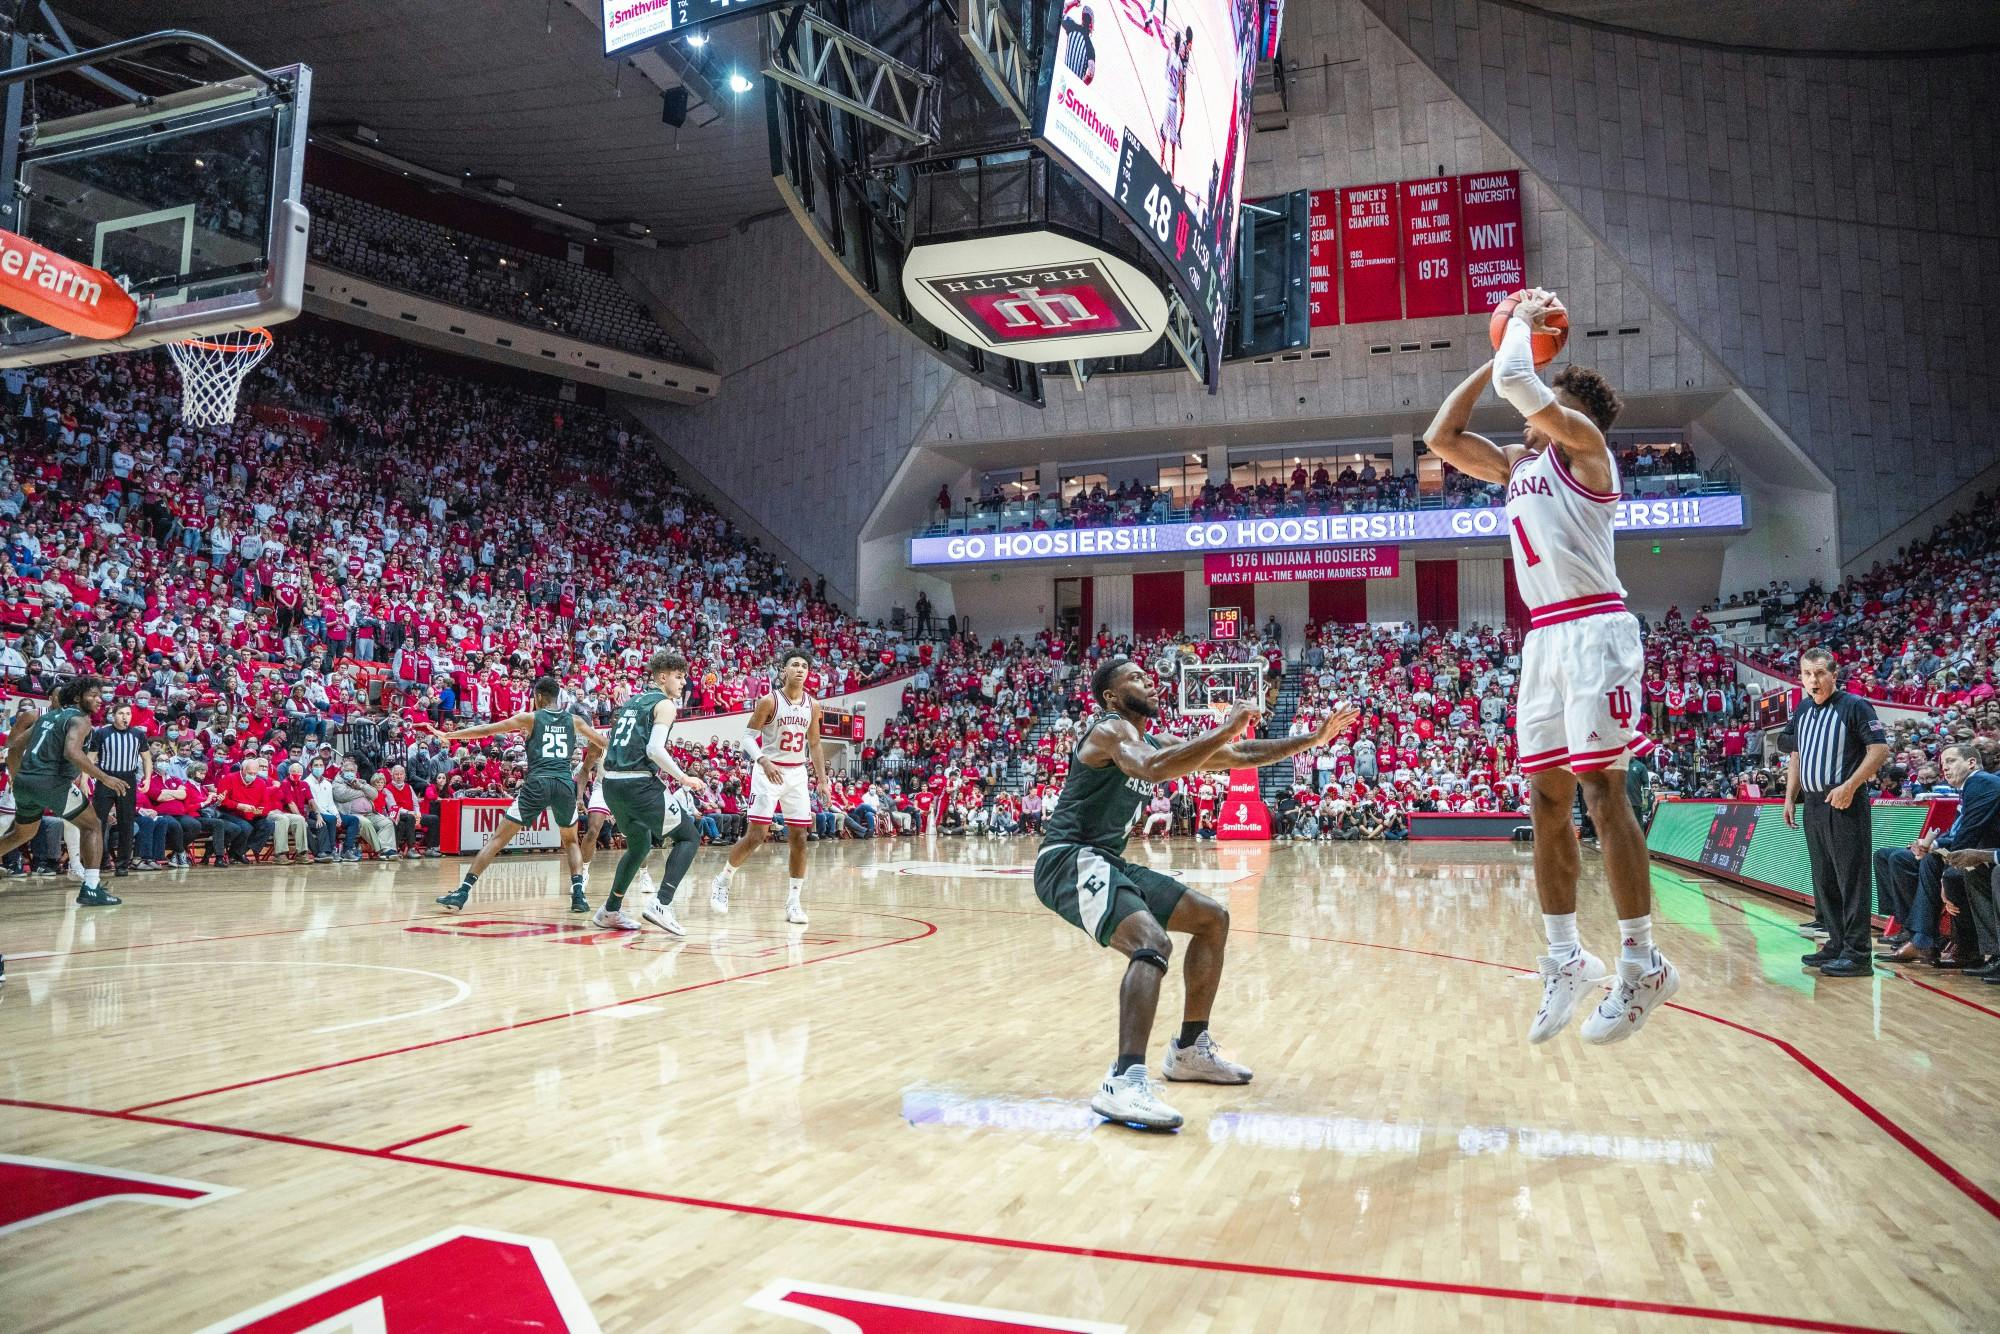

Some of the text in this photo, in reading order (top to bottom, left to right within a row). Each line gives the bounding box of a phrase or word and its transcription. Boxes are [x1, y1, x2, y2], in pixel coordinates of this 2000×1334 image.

[680, 10, 688, 23] 2
[1065, 88, 1119, 152] Smithville
[1124, 130, 1141, 152] FOULS
[1125, 148, 1134, 169] 5
[1409, 181, 1448, 197] WOMEN'S
[1470, 175, 1509, 191] INDIANA
[1120, 183, 1128, 204] 2
[1348, 189, 1387, 203] WOMEN'S
[1464, 188, 1516, 205] UNIVERSITY
[1144, 184, 1171, 242] 48
[1369, 202, 1386, 214] TEN
[1421, 199, 1438, 212] AIAW
[1348, 214, 1390, 229] CHAMPIONS
[1411, 214, 1450, 230] FINAL FOUR
[1311, 229, 1334, 242] SEASON
[1412, 230, 1452, 246] APPEARANCE
[1469, 222, 1517, 251] WNIT
[1192, 229, 1209, 272] 11:58
[1419, 258, 1449, 280] 1973
[1468, 259, 1522, 275] BASKETBALL
[943, 268, 1090, 293] HEALTH
[1472, 272, 1520, 288] CHAMPIONS
[1486, 290, 1508, 305] 2018
[1185, 513, 1416, 547] GO HOOSIERS!!!
[1451, 510, 1498, 534] GO
[948, 528, 1157, 559] GO HOOSIERS!!!
[1512, 515, 1541, 567] 1
[1229, 547, 1377, 568] 1976 INDIANA HOOSIERS
[1211, 566, 1392, 583] NCAA'S #1 ALL-TIME MARCH MADNESS TEAM
[1215, 611, 1237, 621] 11:58
[1216, 621, 1235, 637] 20
[545, 725, 550, 733] N
[613, 717, 637, 746] 23
[542, 732, 568, 758] 25
[780, 731, 804, 752] 23
[1231, 784, 1255, 793] meijer
[668, 803, 679, 815] E
[1222, 823, 1262, 832] Smithville
[1083, 874, 1106, 897] E
